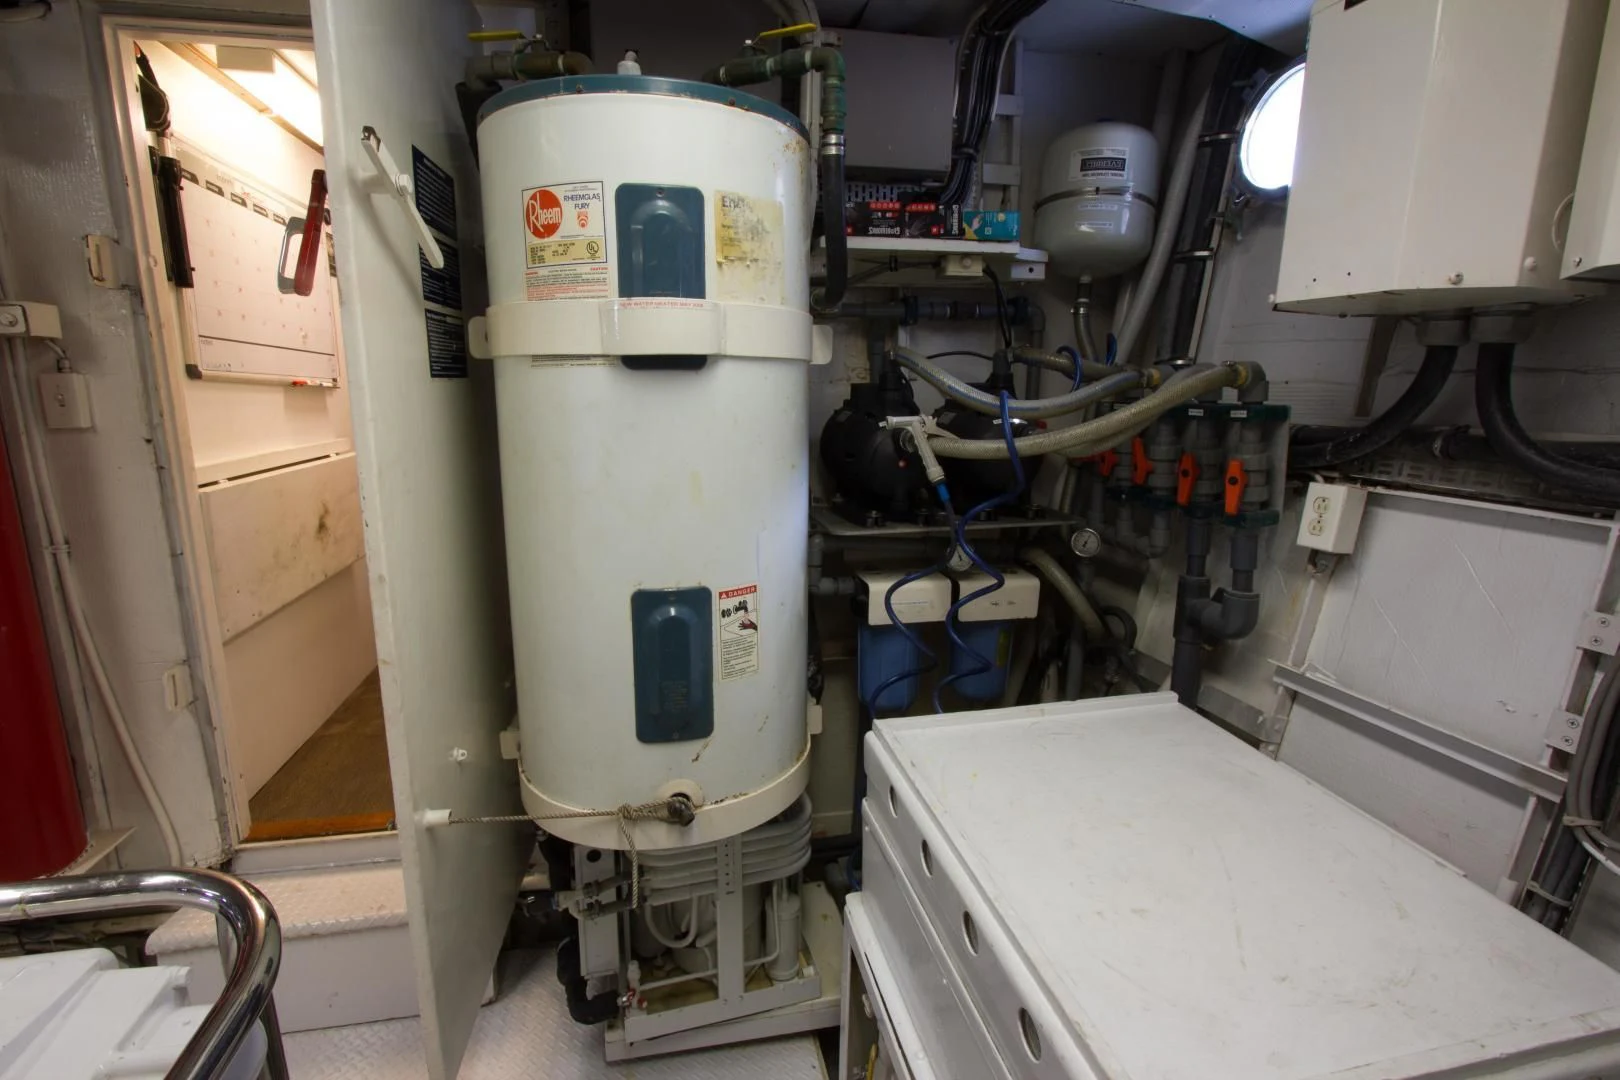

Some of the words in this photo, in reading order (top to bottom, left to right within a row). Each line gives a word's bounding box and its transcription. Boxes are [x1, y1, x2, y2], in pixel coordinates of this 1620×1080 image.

[574, 202, 590, 210] FURY
[529, 192, 562, 233] Rheem
[728, 587, 755, 597] DANGER
